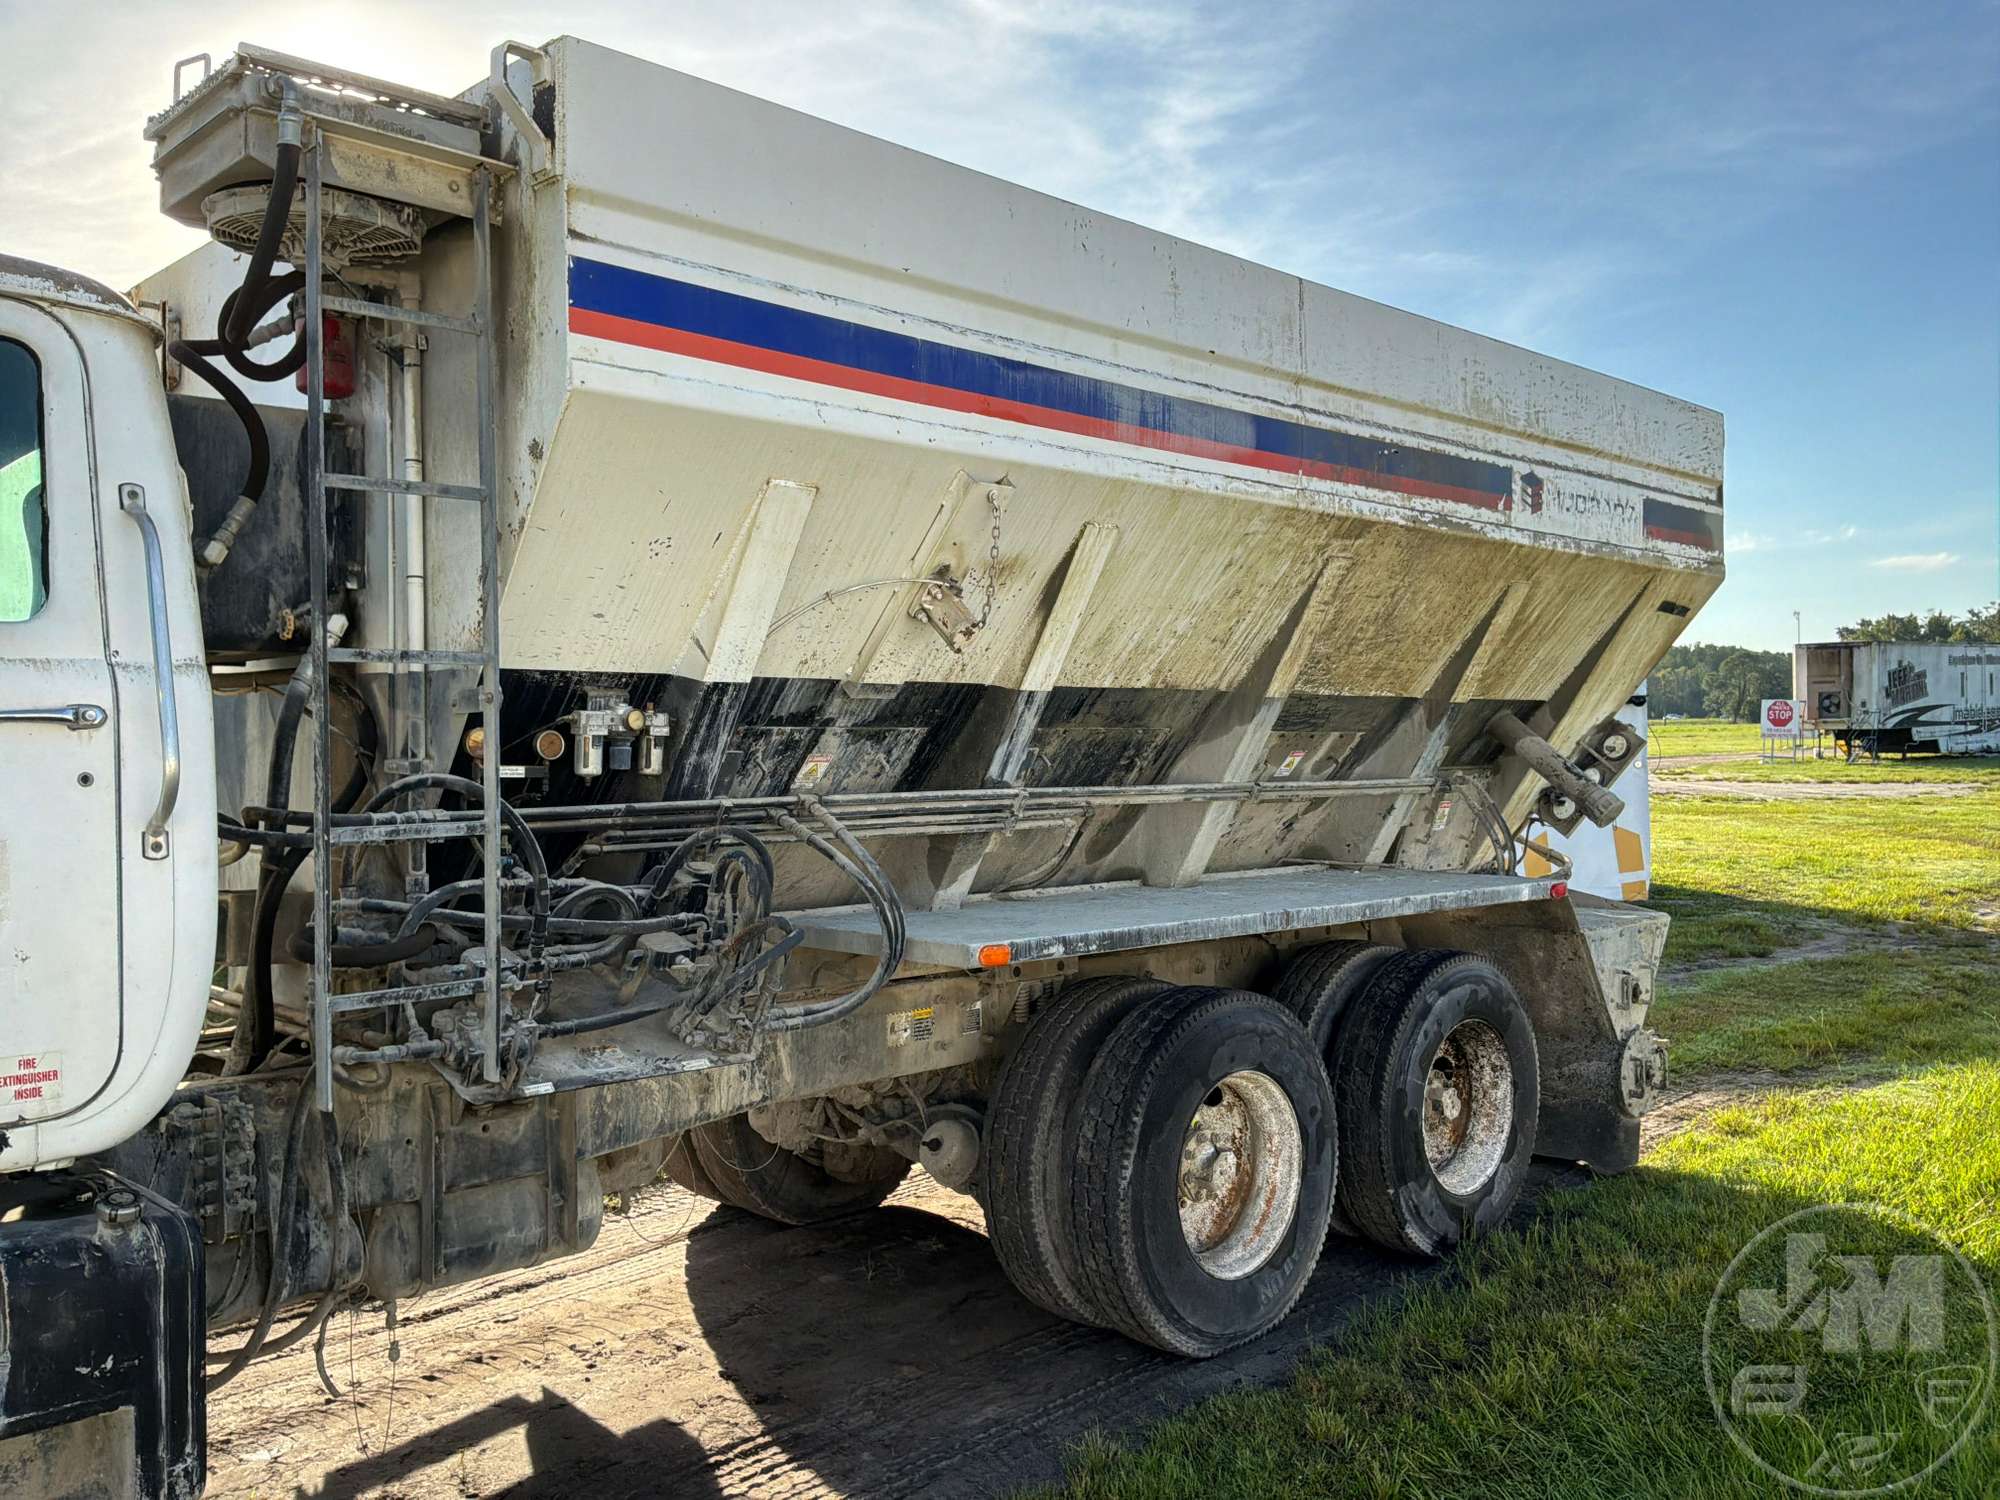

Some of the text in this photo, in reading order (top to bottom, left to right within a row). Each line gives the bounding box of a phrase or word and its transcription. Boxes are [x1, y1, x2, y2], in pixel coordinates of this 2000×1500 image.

[1769, 711, 1792, 719] STOP
[18, 1058, 37, 1070] FIRE
[0, 1070, 58, 1087] EXTINGUISHER
[14, 1087, 43, 1101] INSIDE
